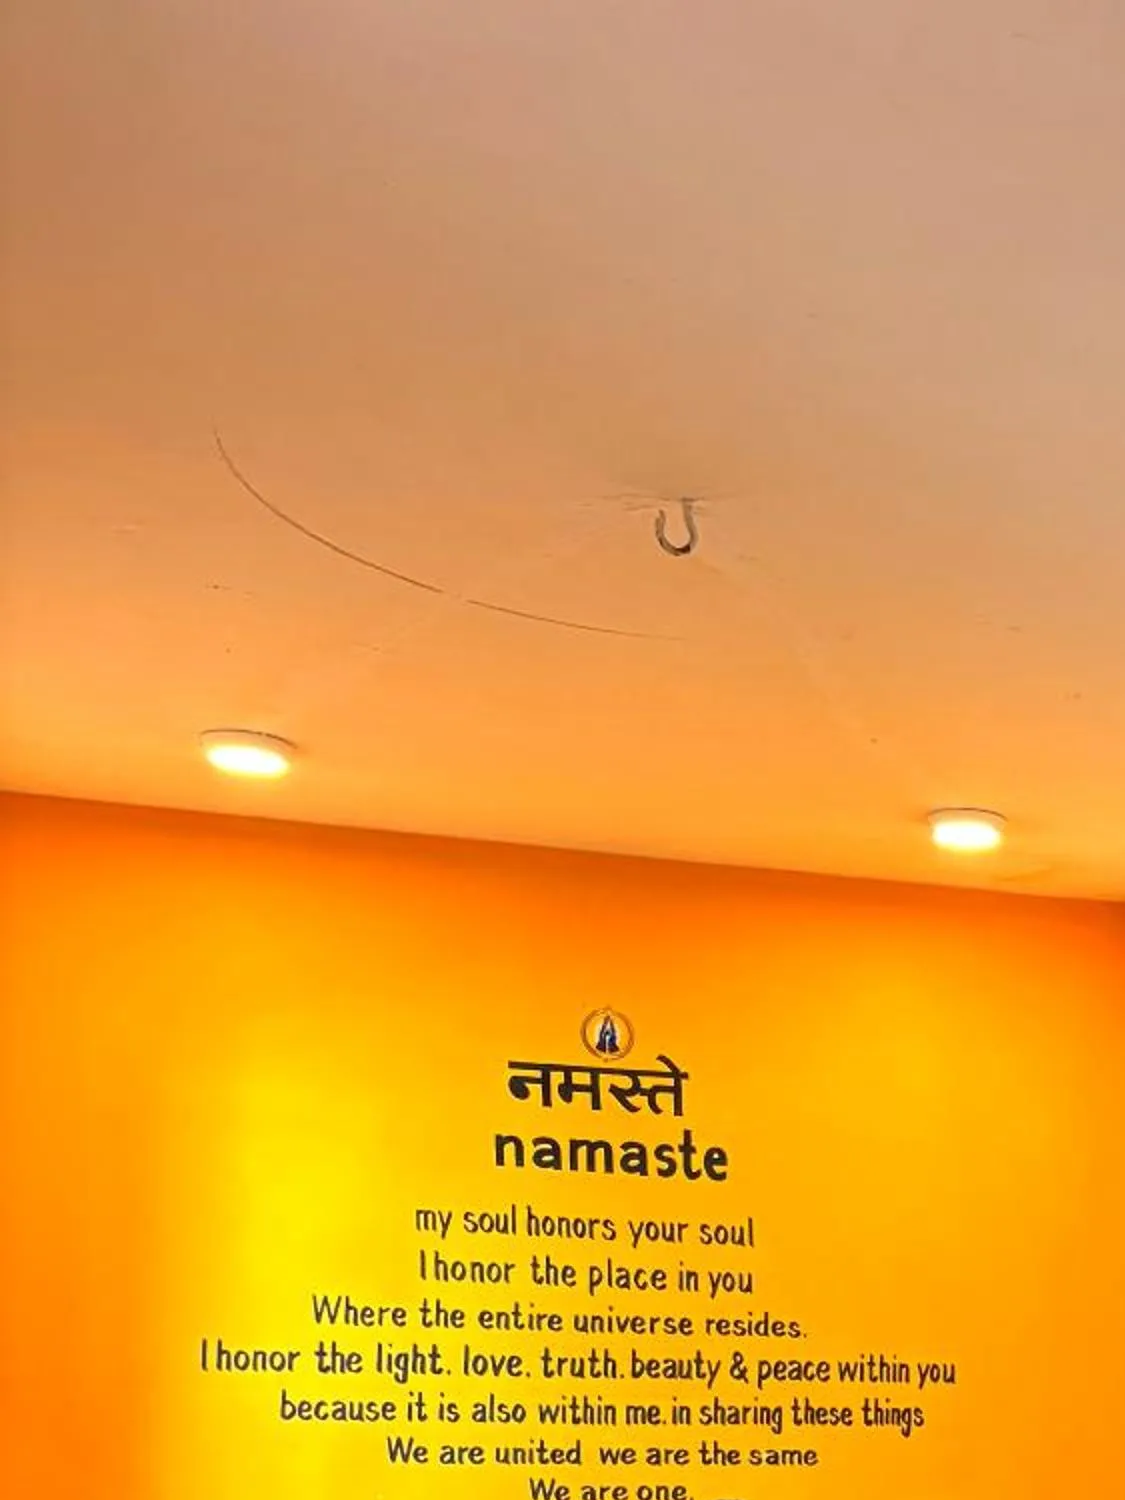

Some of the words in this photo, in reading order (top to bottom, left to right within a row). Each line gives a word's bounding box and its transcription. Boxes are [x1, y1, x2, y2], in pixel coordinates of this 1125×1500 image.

[507, 1055, 690, 1117] नमस्ते
[494, 1128, 729, 1183] namaste
[415, 1209, 453, 1239] my
[463, 1203, 517, 1236] soul
[525, 1205, 617, 1241] honors
[627, 1220, 689, 1249] your
[699, 1216, 755, 1248] soul
[419, 1249, 427, 1281] I
[433, 1250, 516, 1284] honor
[529, 1255, 577, 1288] the
[588, 1257, 668, 1297] place
[677, 1262, 699, 1293] in
[708, 1271, 753, 1300] you
[311, 1294, 407, 1328] Where
[418, 1297, 466, 1329] the
[477, 1301, 564, 1332] entire
[573, 1305, 694, 1337] universe
[705, 1311, 807, 1339] resides.
[201, 1339, 209, 1371] I
[215, 1340, 301, 1373] honor
[313, 1340, 364, 1375] the
[630, 1348, 722, 1390] beauty
[729, 1351, 749, 1385] &
[757, 1359, 831, 1390] peace
[837, 1354, 911, 1384] within
[917, 1362, 956, 1387] you
[279, 1390, 397, 1423] because
[407, 1390, 429, 1423] it
[438, 1392, 461, 1424] is
[471, 1393, 527, 1424] also
[537, 1395, 617, 1427] within
[671, 1396, 692, 1426] in
[698, 1396, 783, 1435] sharing
[790, 1397, 854, 1427] these
[860, 1397, 925, 1439] things
[386, 1437, 429, 1465] We
[439, 1444, 486, 1465] are
[495, 1439, 583, 1466] united
[598, 1447, 637, 1466] we
[645, 1447, 691, 1467] are
[697, 1440, 742, 1467] the
[747, 1449, 819, 1467] same
